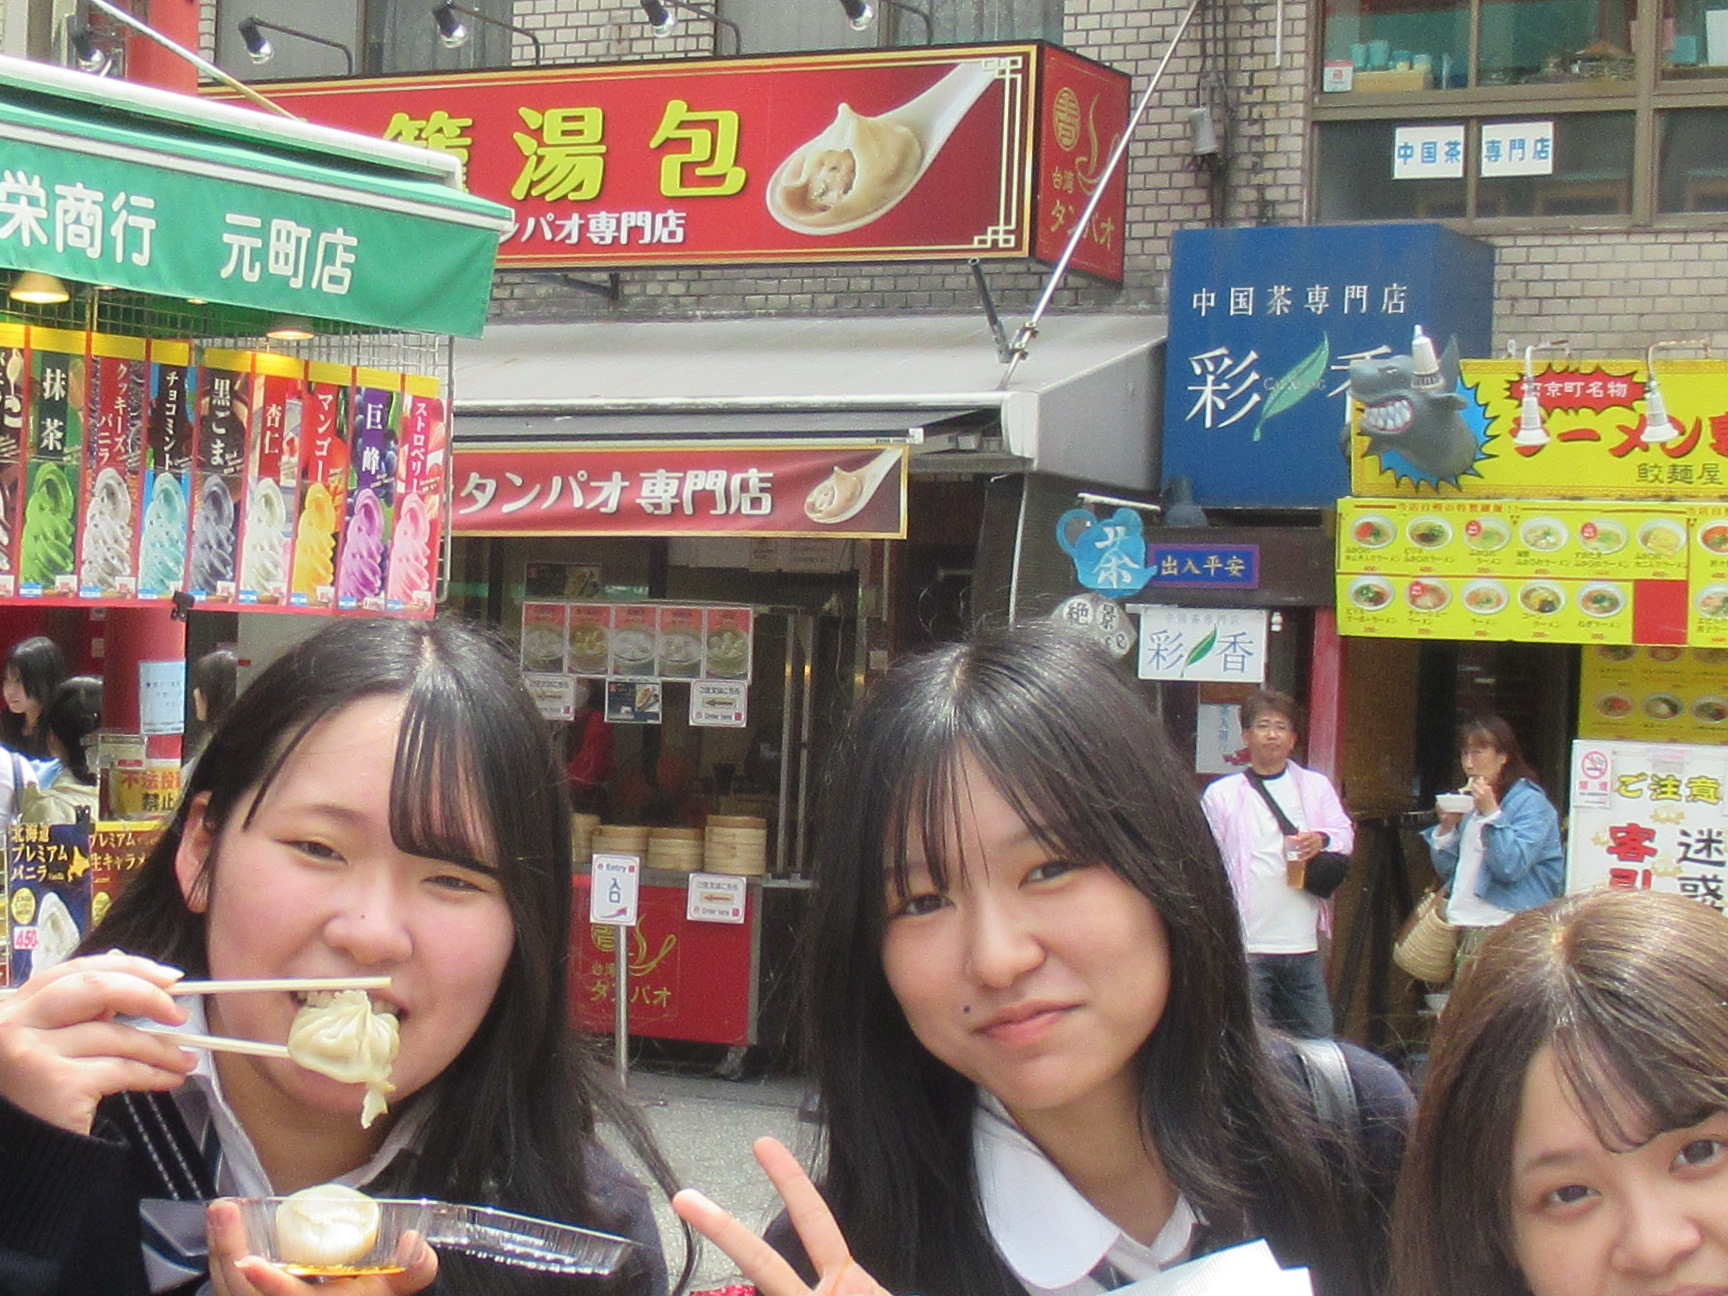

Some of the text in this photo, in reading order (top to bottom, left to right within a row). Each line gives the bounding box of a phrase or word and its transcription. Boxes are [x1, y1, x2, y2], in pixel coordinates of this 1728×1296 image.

[1396, 136, 1553, 168] 中国茶 専門店
[220, 212, 359, 295] 元町店
[1192, 283, 1408, 317] 中国茶専門店
[41, 367, 67, 452] 抹茶
[163, 371, 179, 470] チョコミント
[210, 377, 232, 467] 黒ごま
[263, 403, 284, 454] 杏仁
[98, 415, 114, 465] バニラ
[314, 392, 334, 483] マンゴー
[362, 404, 382, 476] 巨峰
[409, 401, 429, 493] ストロベリー
[459, 468, 775, 515] タンパオ専門店
[1091, 525, 1141, 590] 茶
[1161, 547, 1247, 580] 出入平安
[1147, 628, 1255, 674] 彩香
[142, 792, 176, 812] 禁止
[1617, 771, 1722, 805] ご注意
[11, 824, 50, 843] 北海道
[13, 845, 69, 864] プレミアム
[89, 831, 136, 849] プレミアム
[11, 864, 48, 883] バニラ
[605, 863, 627, 874] Entry
[608, 877, 622, 904] 入口
